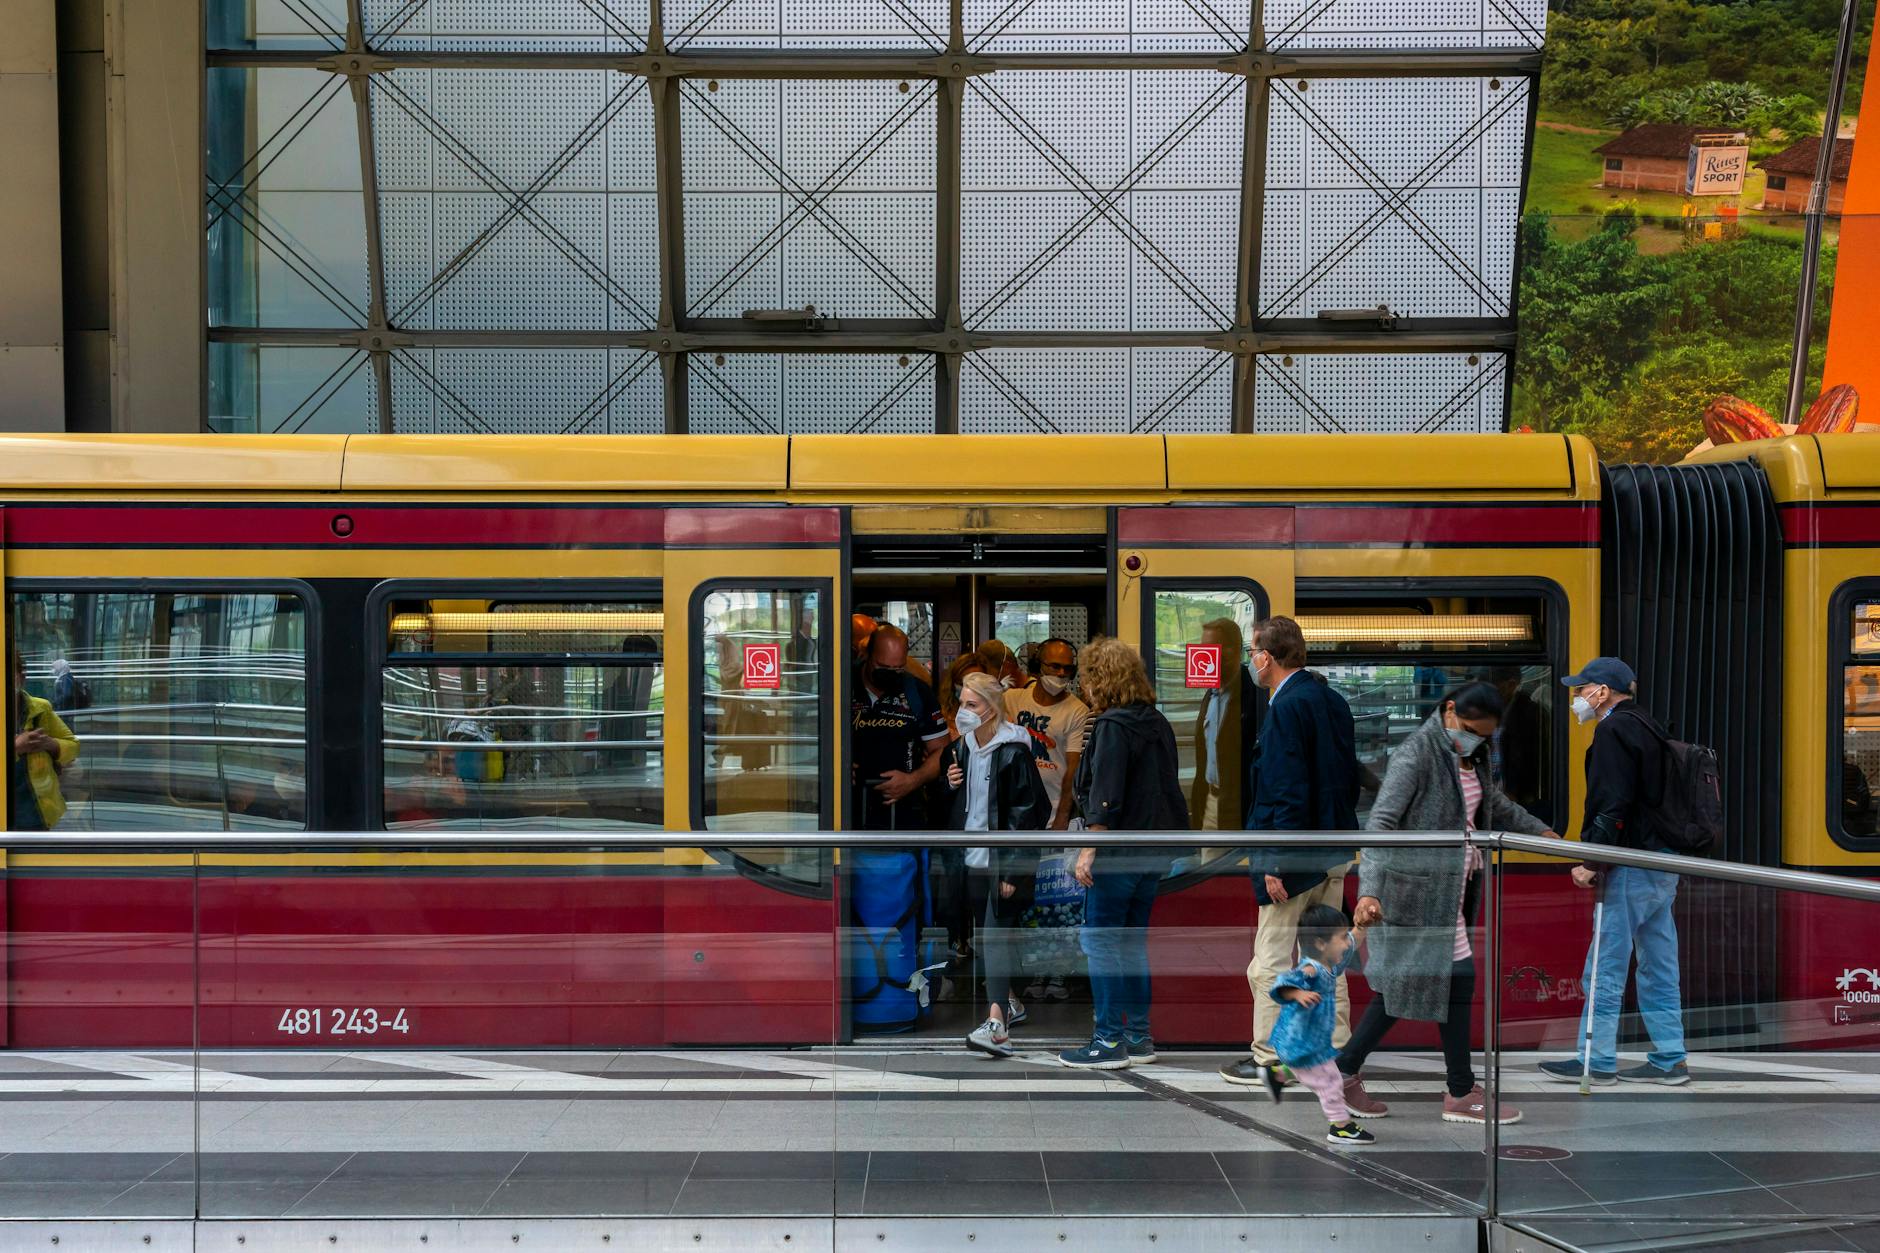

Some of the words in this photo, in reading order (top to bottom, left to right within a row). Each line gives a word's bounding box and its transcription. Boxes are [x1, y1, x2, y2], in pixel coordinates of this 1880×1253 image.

[1703, 173, 1739, 182] SPORT
[278, 1008, 321, 1034] 481
[330, 1008, 409, 1034] 243-4
